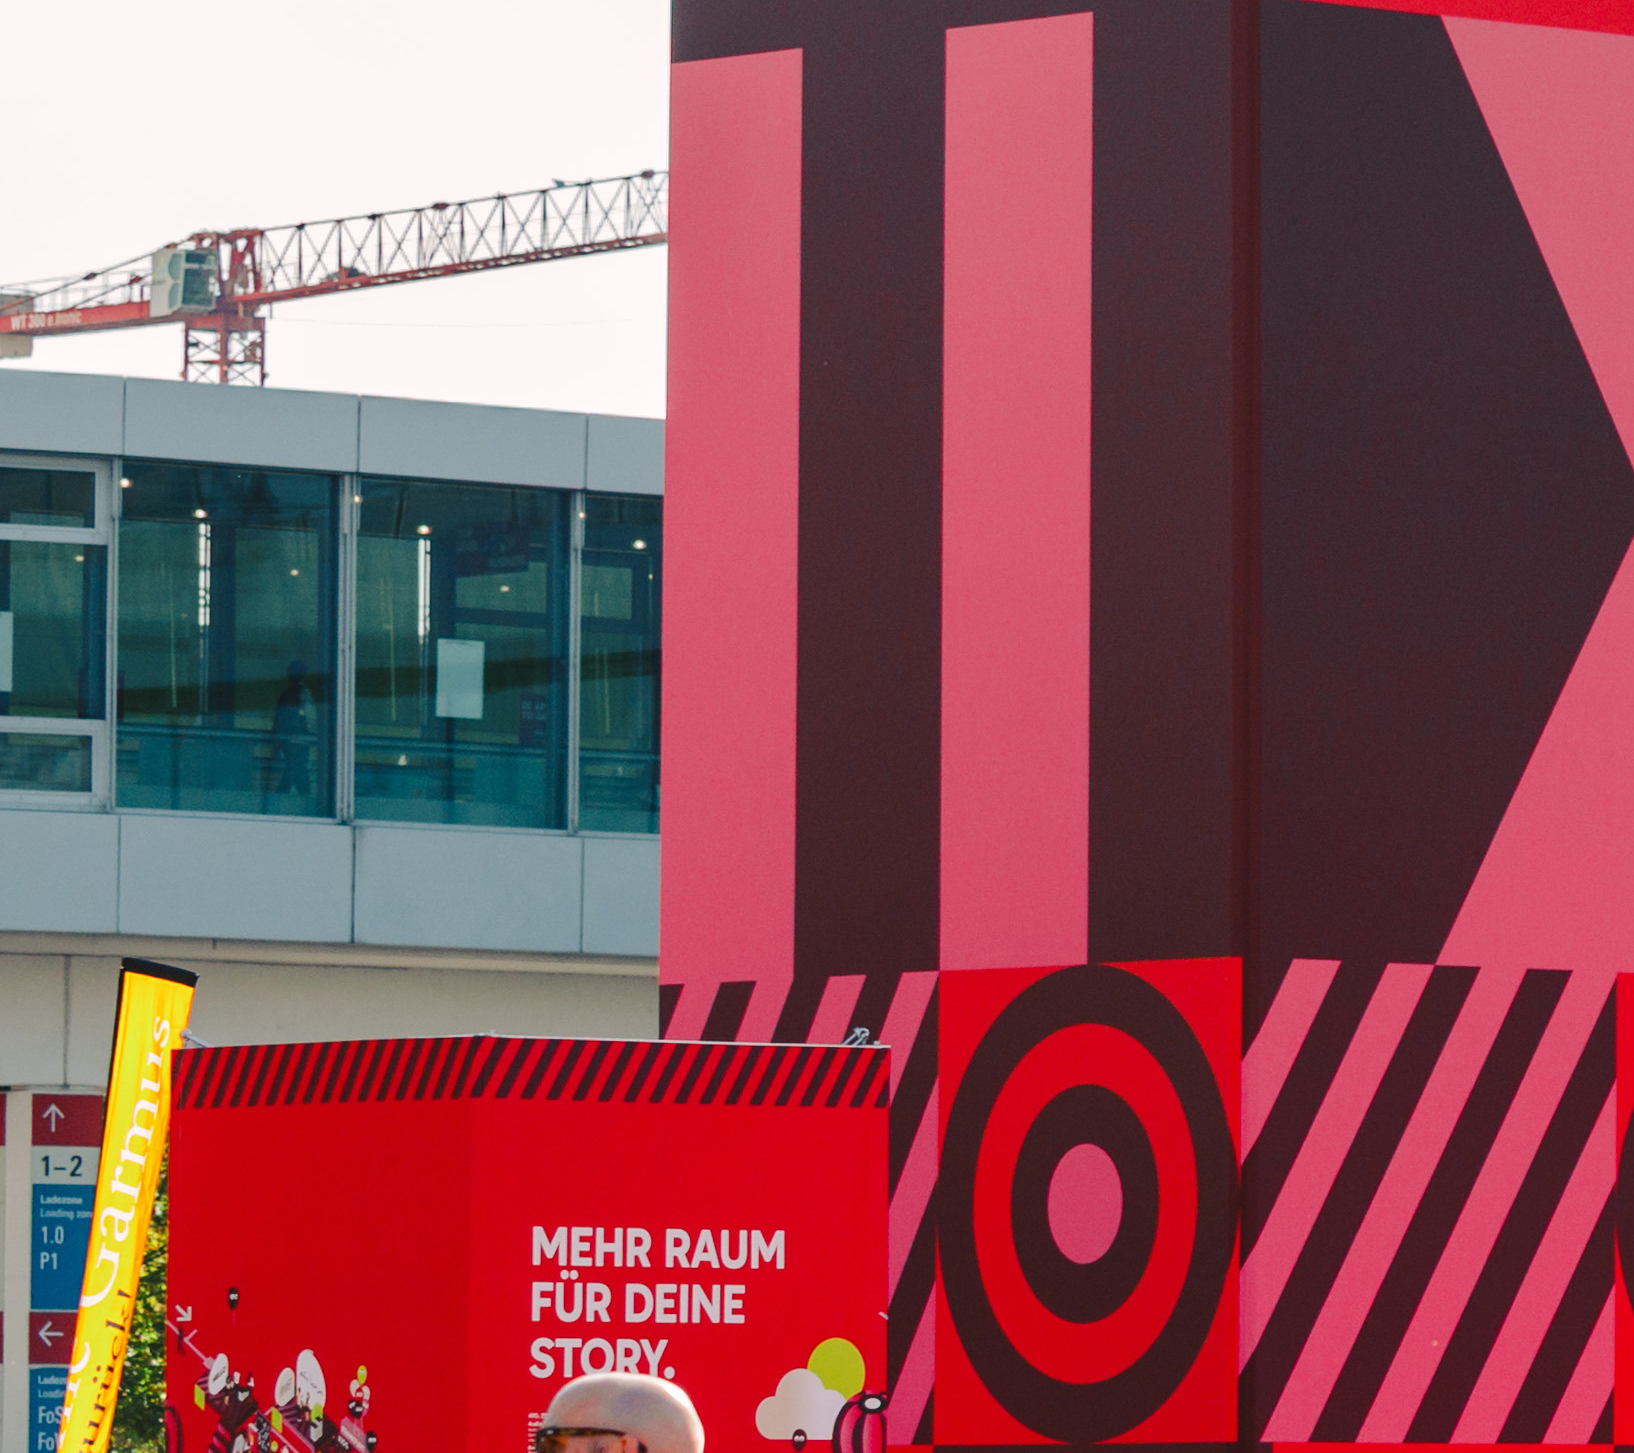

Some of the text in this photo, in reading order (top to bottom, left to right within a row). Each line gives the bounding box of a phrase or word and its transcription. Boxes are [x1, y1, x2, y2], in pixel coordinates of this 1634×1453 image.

[41, 1226, 64, 1244] 1.0
[532, 1226, 785, 1270] MEHR RAUM
[40, 1253, 57, 1270] P1
[531, 1269, 746, 1324] FÜR DEINE
[529, 1337, 675, 1379] STORY.
